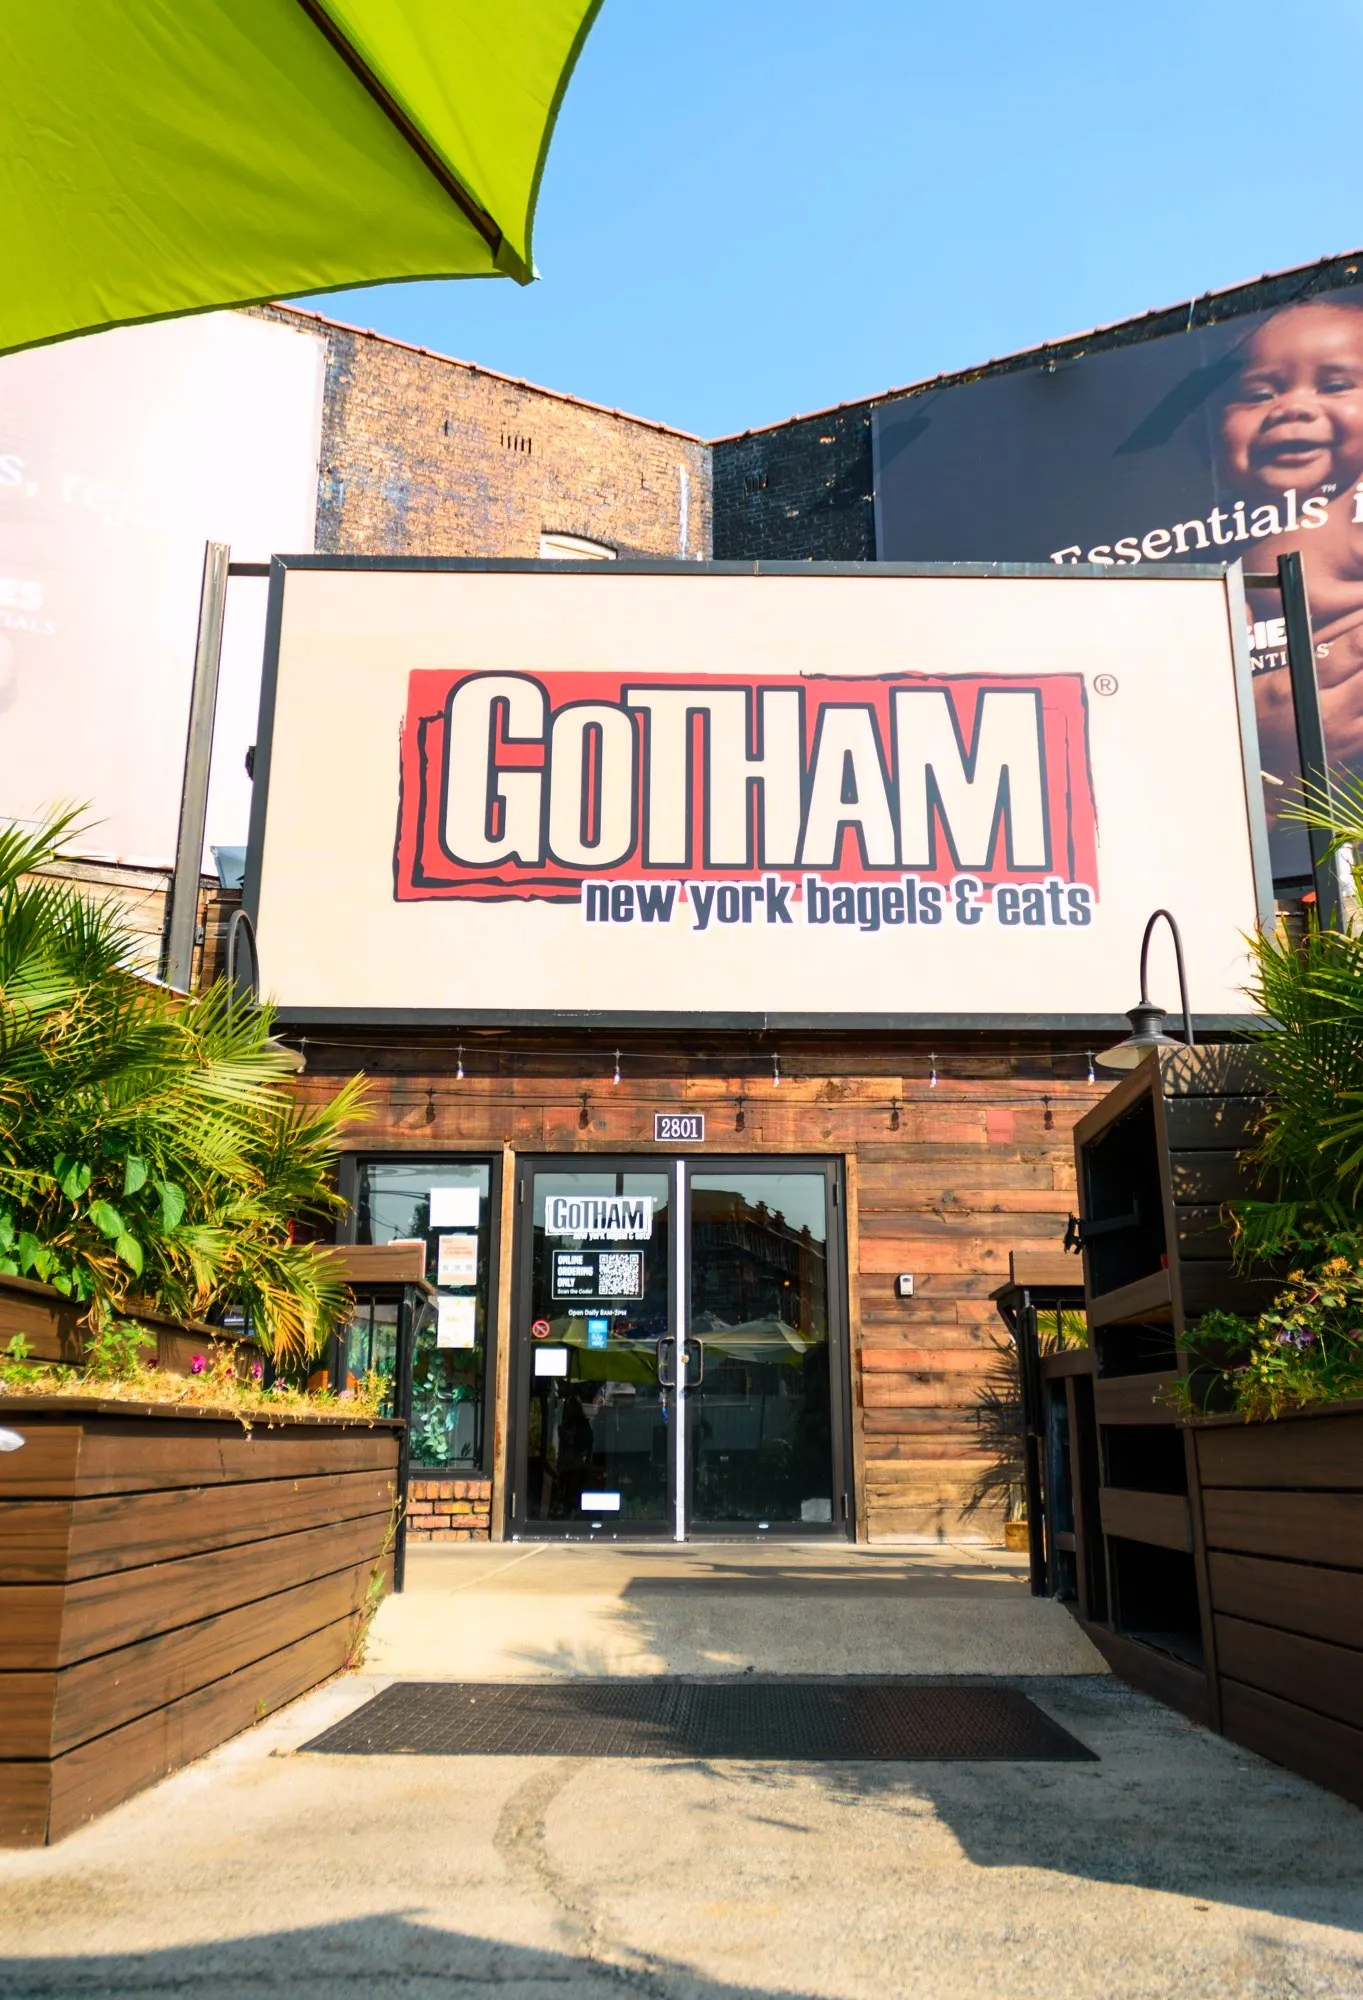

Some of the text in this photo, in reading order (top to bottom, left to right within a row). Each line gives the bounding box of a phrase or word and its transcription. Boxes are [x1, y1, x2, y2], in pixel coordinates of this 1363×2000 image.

[445, 671, 1053, 870] GOTHAM
[586, 877, 1091, 932] new york bagels & eats
[661, 1118, 698, 1138] 2801
[553, 1198, 644, 1230] GOTHAM
[557, 1255, 584, 1265] ONLINE
[557, 1266, 594, 1276] ORDERING
[557, 1277, 576, 1287] ONLY
[568, 1309, 584, 1317] Open
[585, 1309, 600, 1317] Daily
